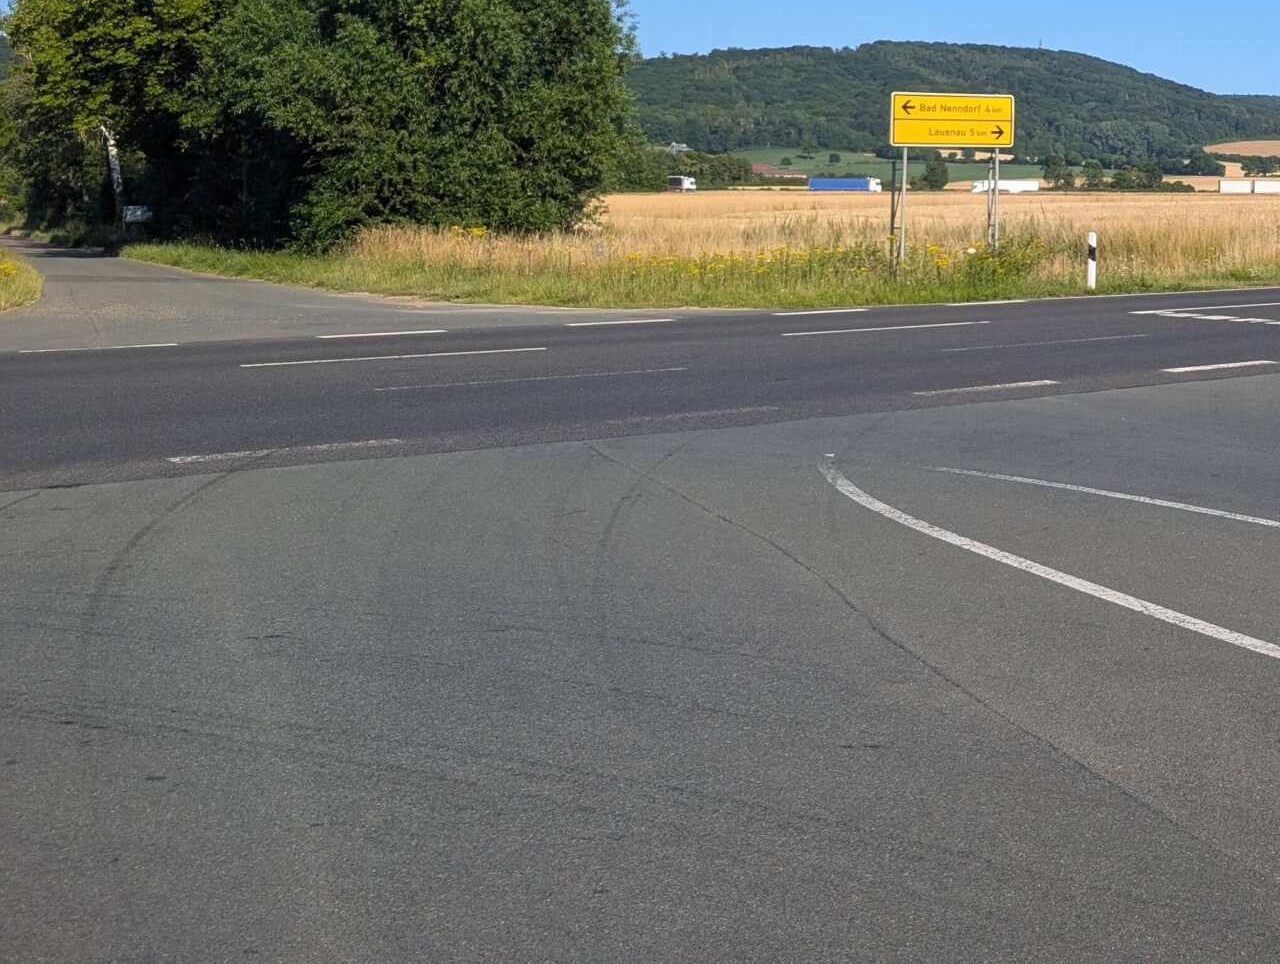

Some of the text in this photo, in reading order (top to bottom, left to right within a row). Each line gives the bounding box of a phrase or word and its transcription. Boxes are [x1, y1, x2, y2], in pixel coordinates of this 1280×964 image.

[919, 103, 937, 113] Bad
[940, 103, 981, 114] Nenndorf
[985, 105, 991, 113] 4
[928, 127, 987, 137] Lauenau 5 km
